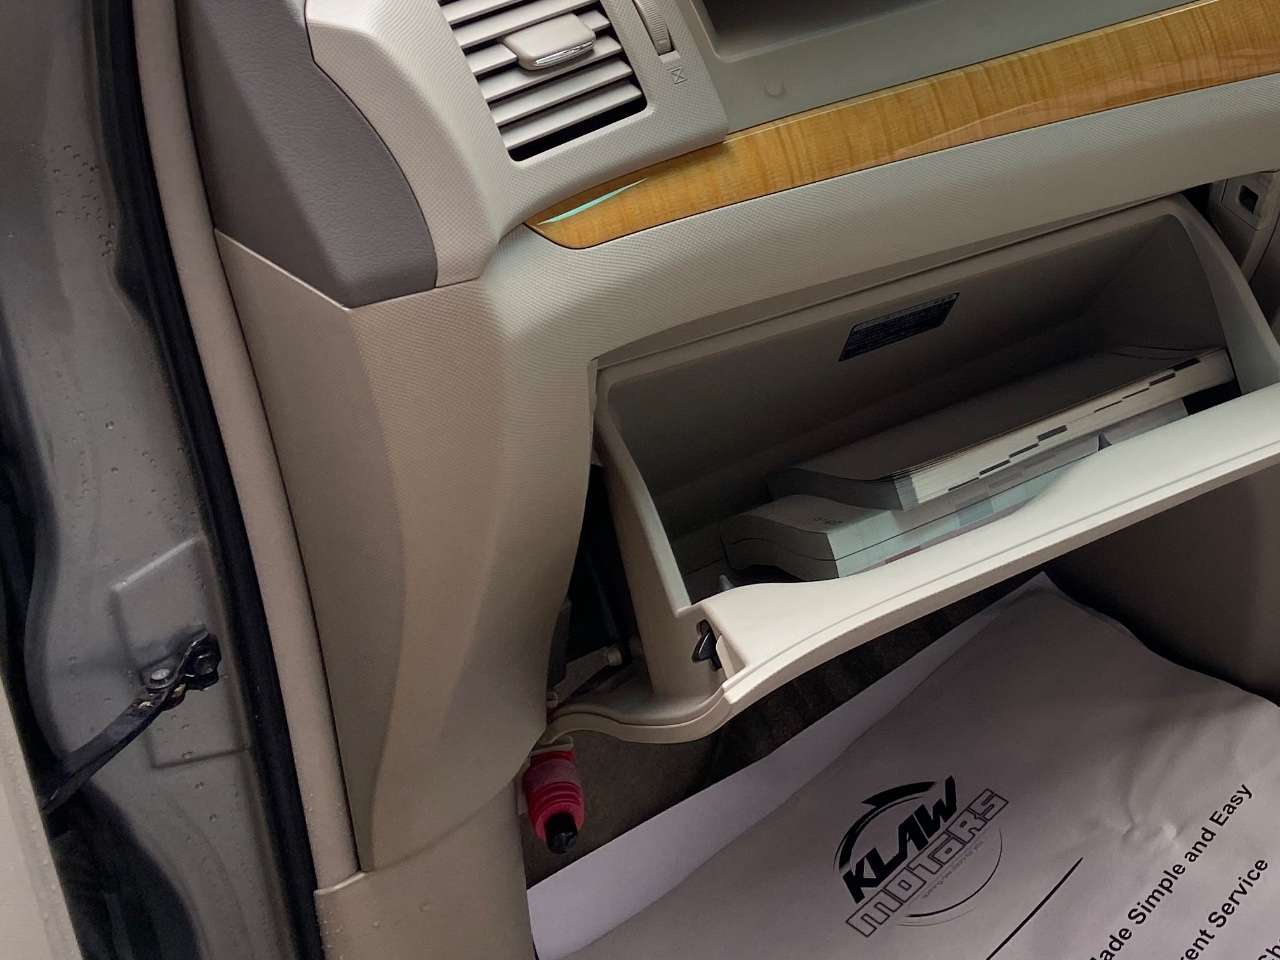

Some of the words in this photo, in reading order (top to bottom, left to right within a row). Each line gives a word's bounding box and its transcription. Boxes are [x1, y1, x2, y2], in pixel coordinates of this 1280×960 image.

[843, 775, 957, 904] KLAW
[846, 788, 1009, 937] MOTORS
[1089, 928, 1132, 960] ade
[1127, 863, 1186, 925] Simple
[1184, 827, 1216, 862] and
[1209, 784, 1253, 826] Easy
[1208, 859, 1268, 928] Service
